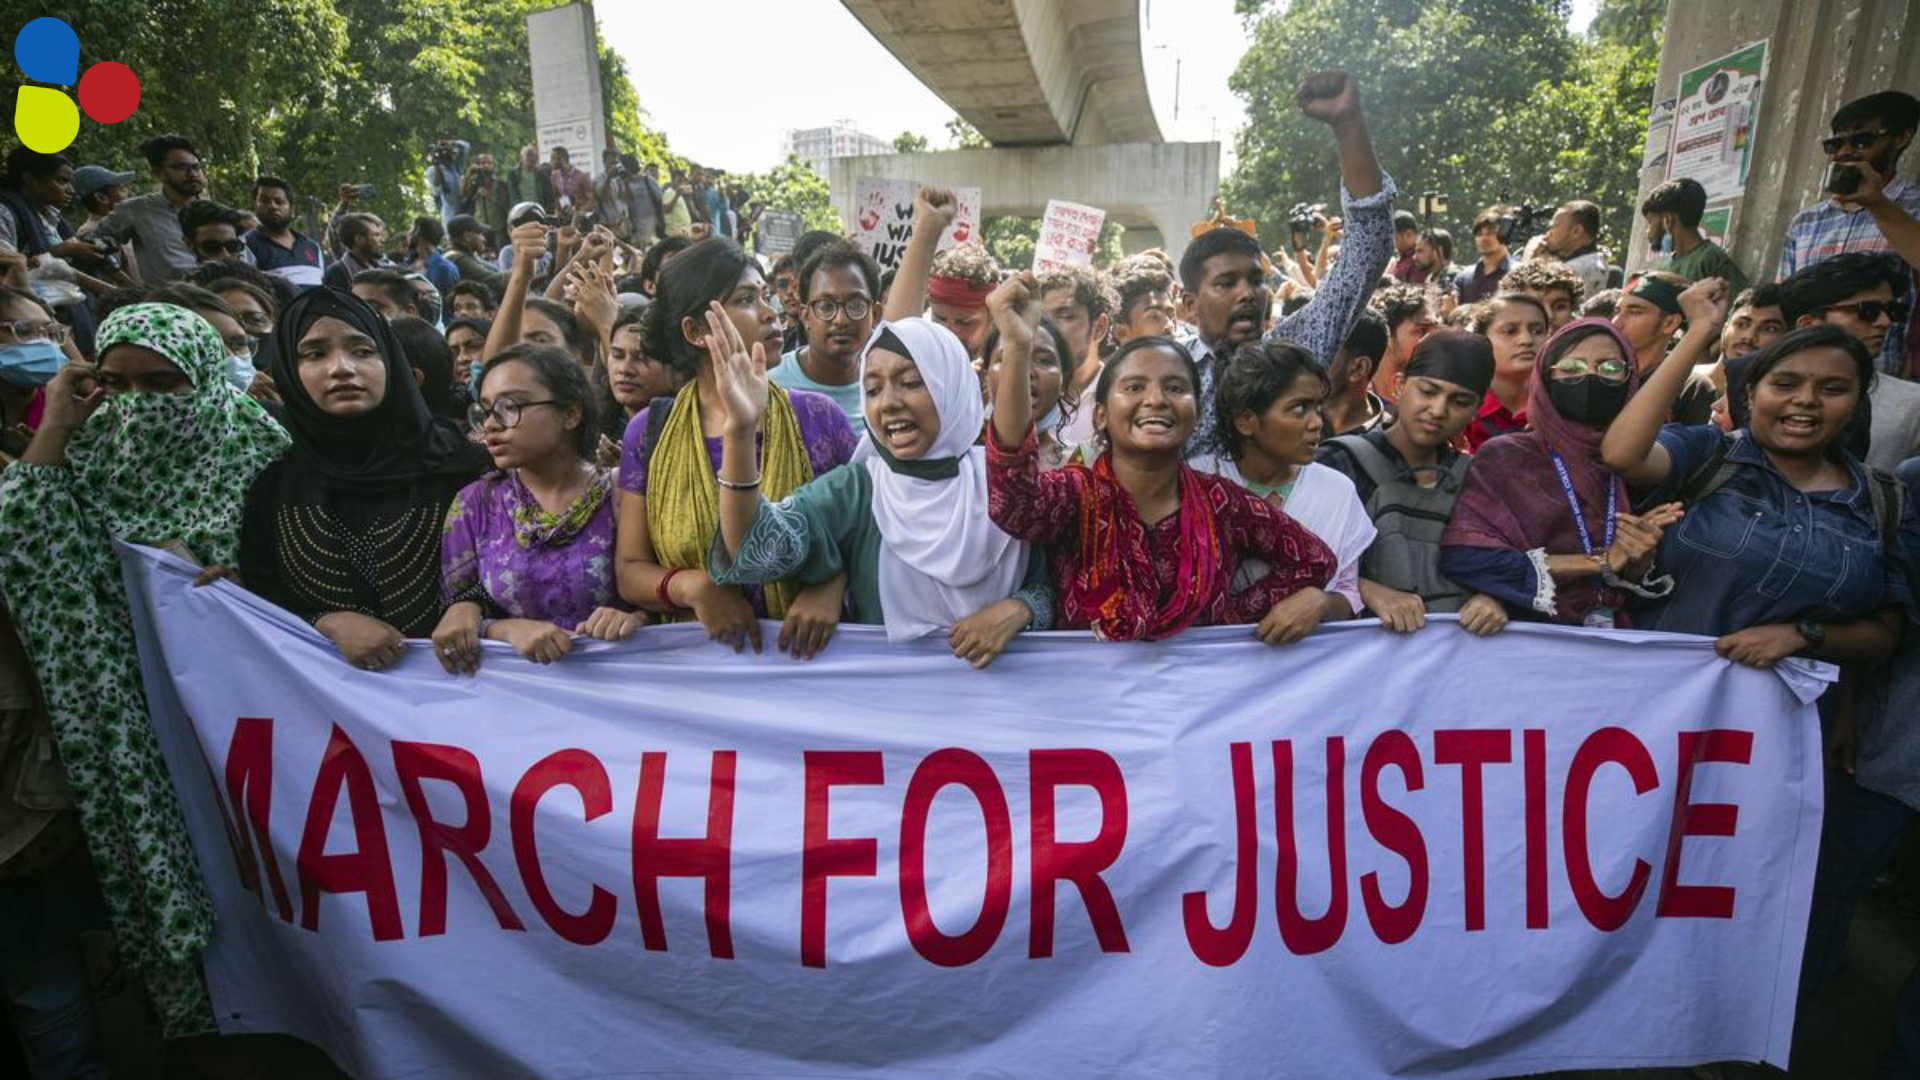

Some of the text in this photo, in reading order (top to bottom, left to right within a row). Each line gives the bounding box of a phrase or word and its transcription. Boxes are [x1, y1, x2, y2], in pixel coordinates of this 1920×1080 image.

[894, 202, 914, 220] W
[887, 223, 913, 242] WA
[188, 716, 1754, 969] MARCH FOR JUSTICE
